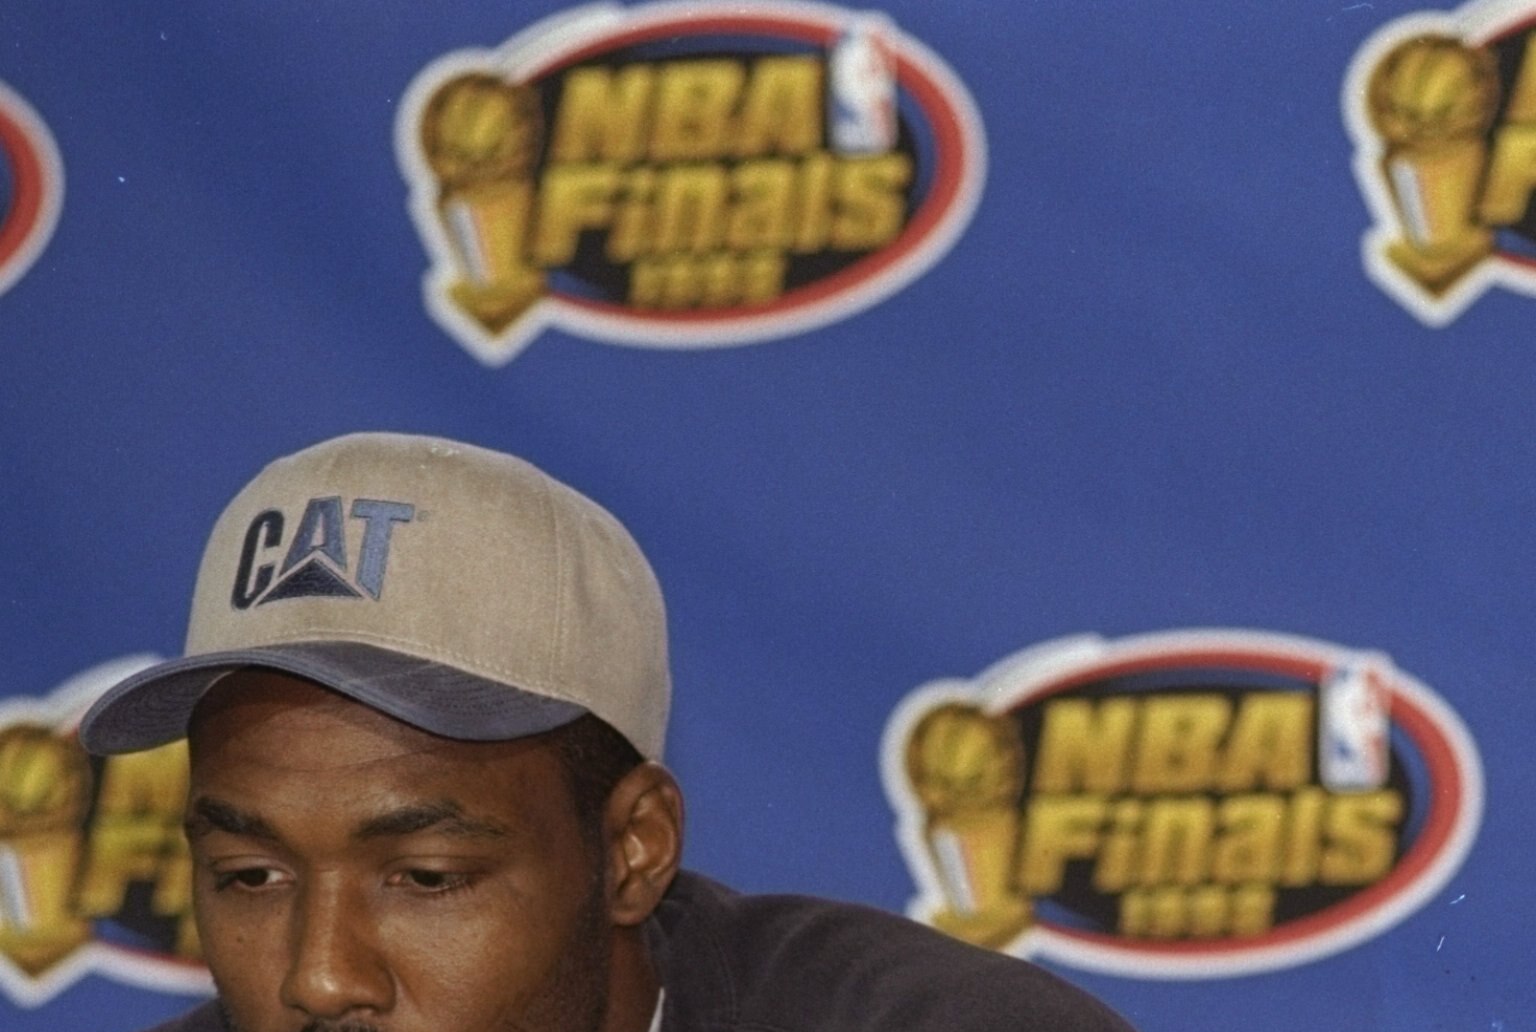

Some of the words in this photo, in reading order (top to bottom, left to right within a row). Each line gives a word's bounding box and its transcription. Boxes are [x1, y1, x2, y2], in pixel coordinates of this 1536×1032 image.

[550, 55, 824, 161] NBA
[530, 150, 912, 264] Finals
[231, 496, 414, 610] CAT
[1031, 690, 1314, 793] NBA
[1016, 785, 1404, 894] Finals
